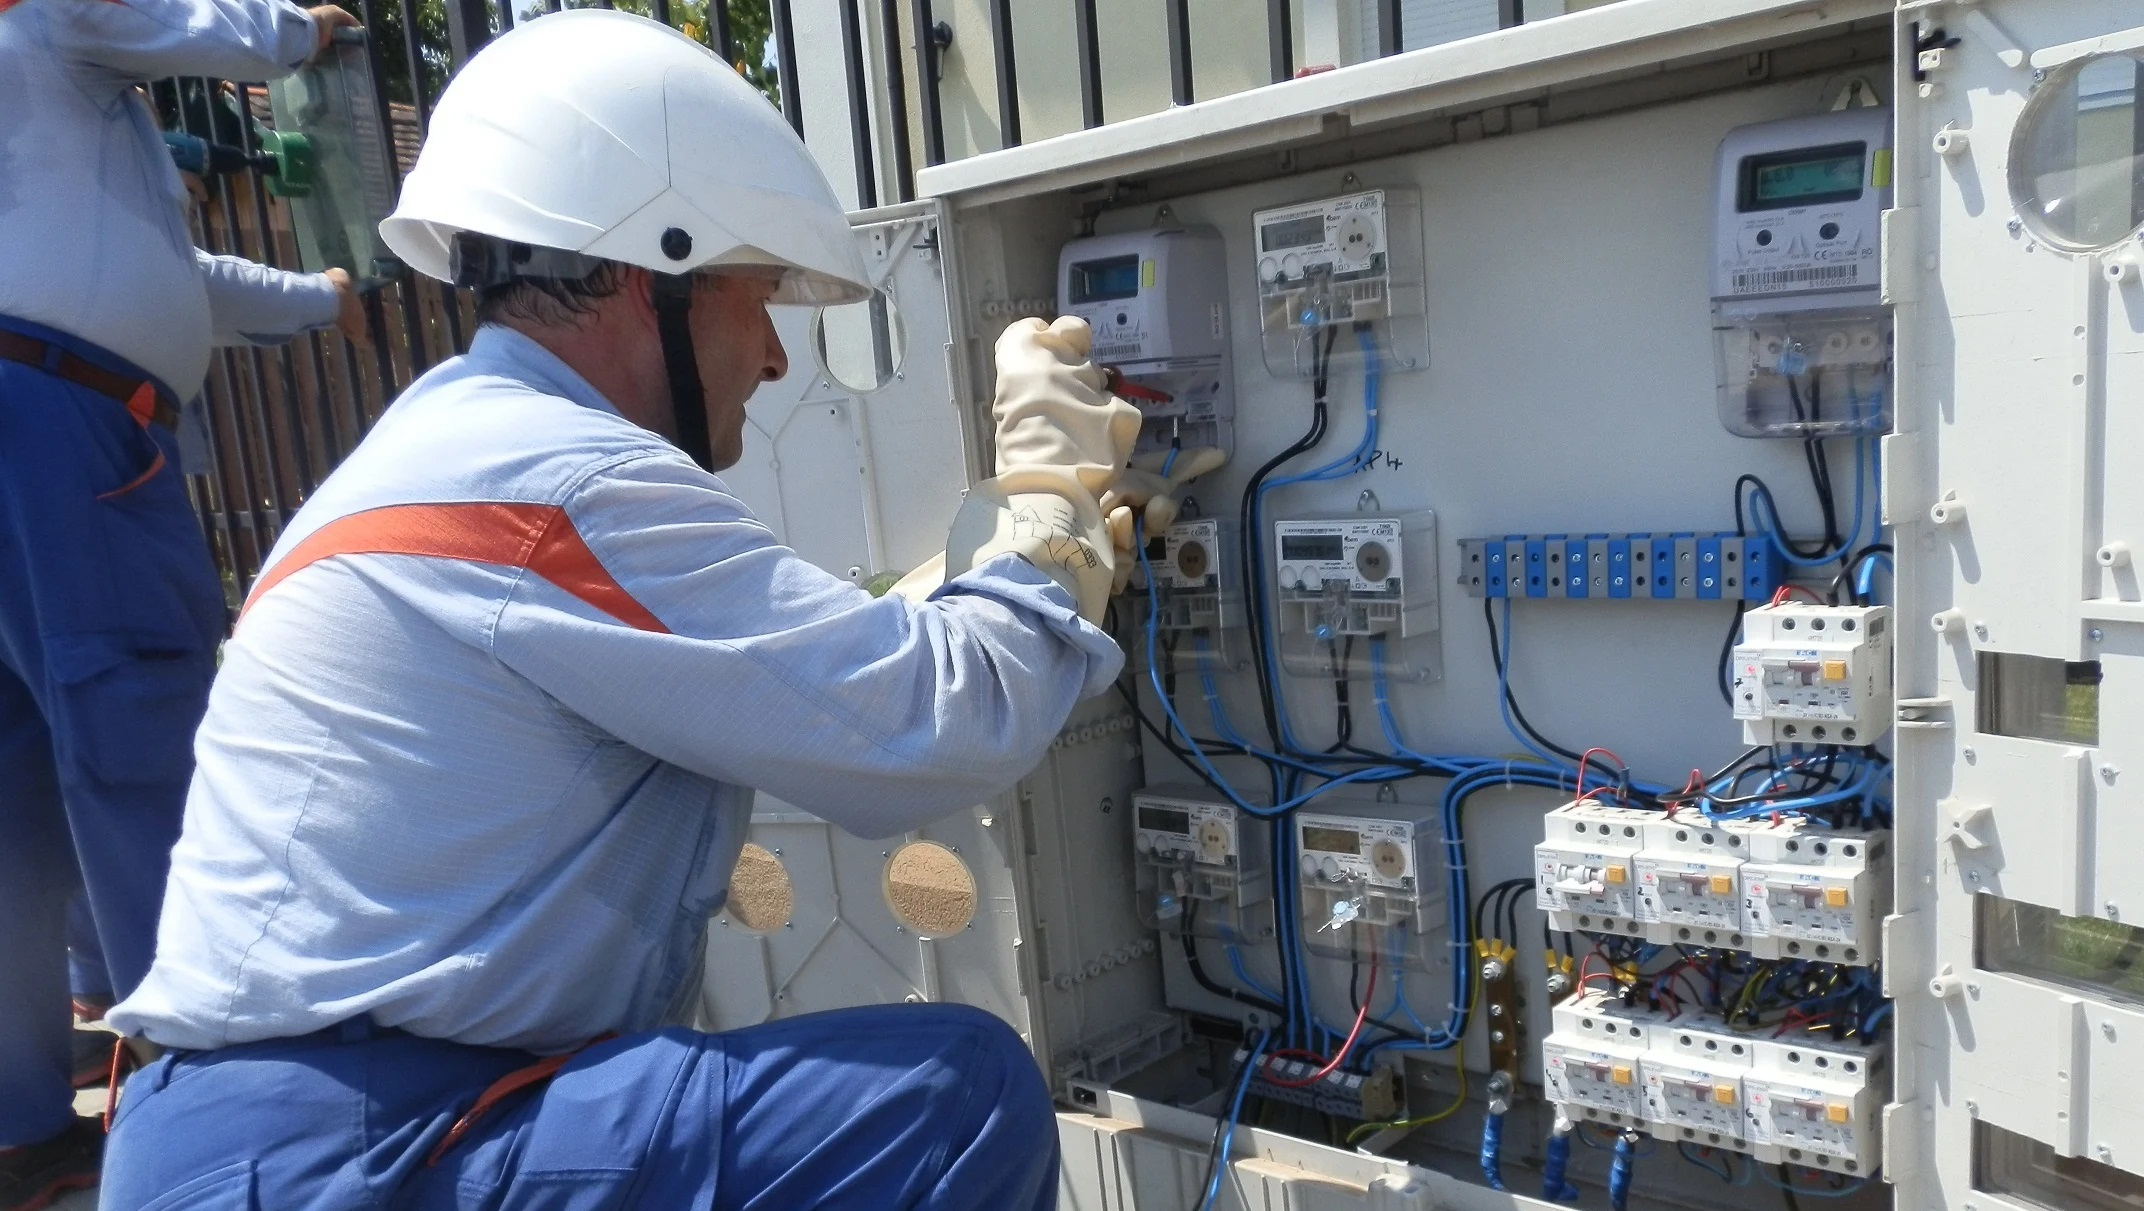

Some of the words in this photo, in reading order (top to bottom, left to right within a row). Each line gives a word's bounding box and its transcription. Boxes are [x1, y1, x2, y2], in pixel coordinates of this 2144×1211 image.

[1637, 886, 1645, 896] 2
[1746, 898, 1753, 909] 3
[1745, 1107, 1754, 1119] 6
